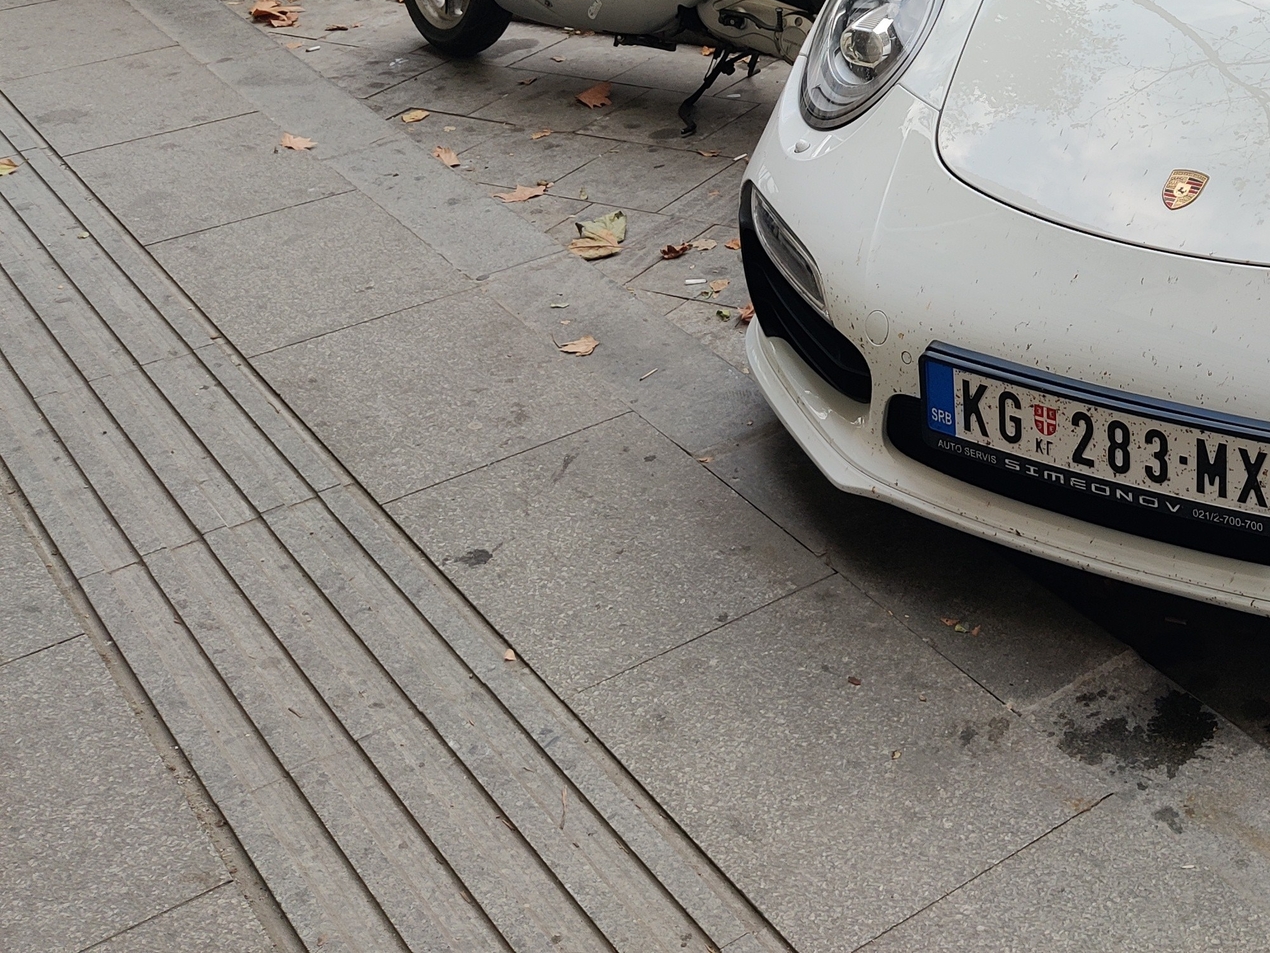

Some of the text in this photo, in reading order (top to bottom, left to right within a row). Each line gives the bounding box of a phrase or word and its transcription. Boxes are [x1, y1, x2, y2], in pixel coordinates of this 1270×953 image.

[931, 407, 953, 426] SRB
[962, 379, 1023, 445] KG
[937, 439, 1264, 533] AUTO SERVIS SIMEONOV 021/2-700-700
